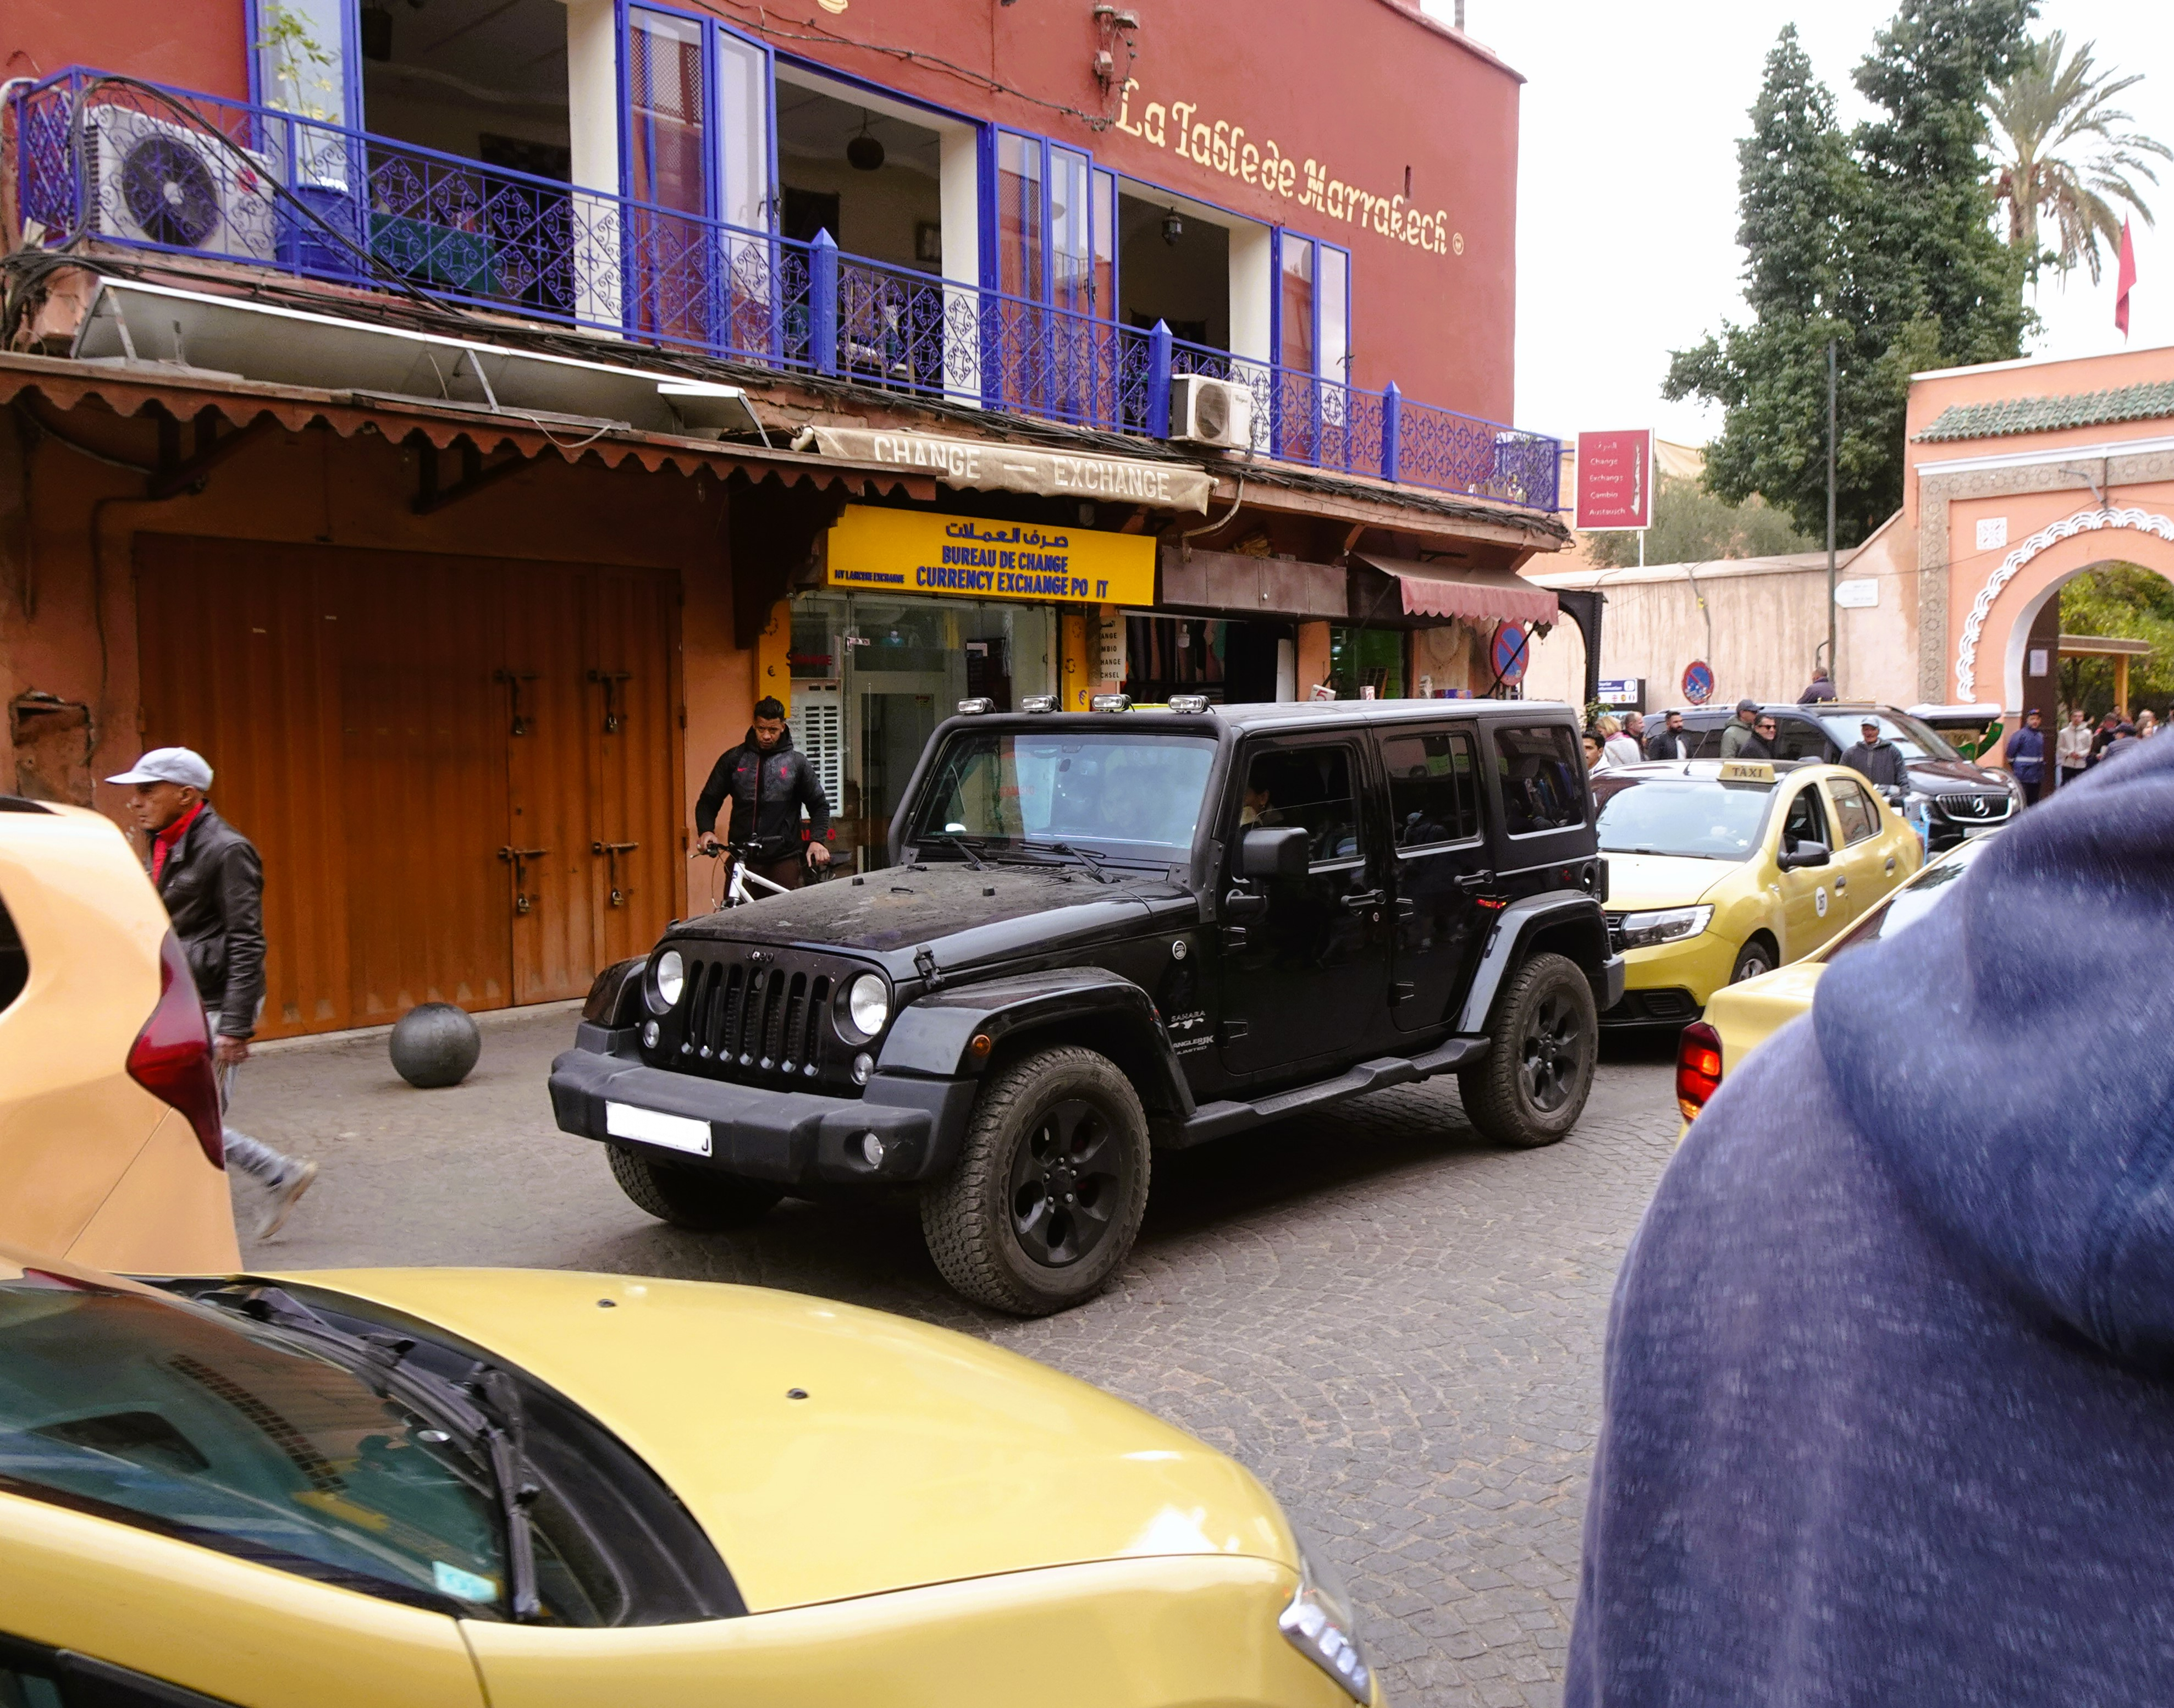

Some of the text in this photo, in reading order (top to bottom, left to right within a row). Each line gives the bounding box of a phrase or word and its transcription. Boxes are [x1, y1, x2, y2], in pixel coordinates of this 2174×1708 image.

[1116, 78, 1447, 255] La Table de Marrakech
[1590, 458, 1618, 467] Change
[874, 436, 1171, 501] CHANGE EXCHANGE
[1589, 475, 1624, 483] Exchange
[1590, 491, 1618, 500] Cambio
[1589, 507, 1626, 516] Austausch
[946, 523, 1068, 549] صرف العملات
[942, 545, 1068, 573] BUREAU DE CHANGE
[917, 566, 1108, 598] CURRENCY EXCHANGE PO IT
[1732, 767, 1763, 778] TAXI
[1171, 1010, 1206, 1022] SAHARA
[1176, 1046, 1207, 1055] LIMITED
